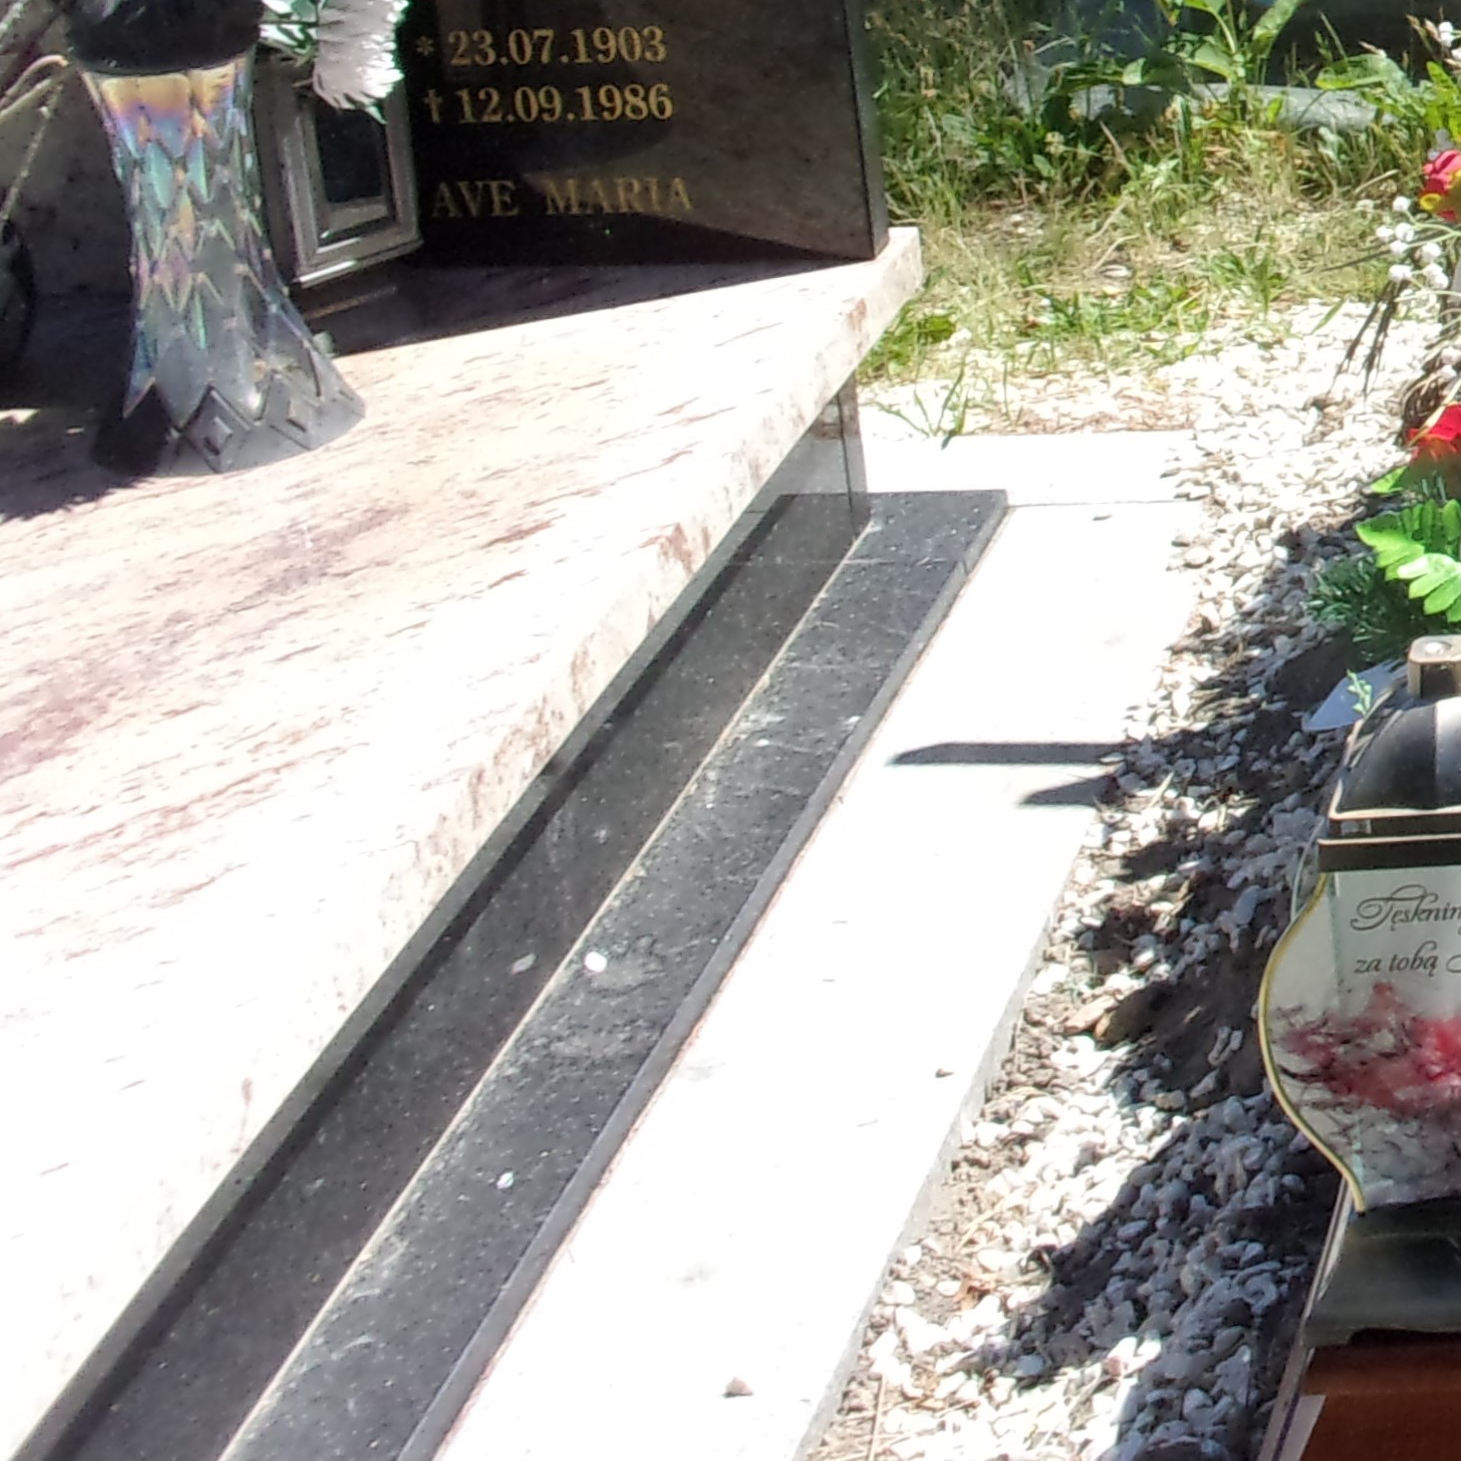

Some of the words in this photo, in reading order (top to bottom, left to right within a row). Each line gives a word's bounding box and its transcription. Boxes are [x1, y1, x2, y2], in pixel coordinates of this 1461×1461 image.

[447, 27, 668, 67] 23.07.1903
[457, 84, 676, 124] 12.09.1986
[434, 180, 517, 218] AVE
[544, 176, 693, 217] MARIA
[1354, 957, 1381, 974] za
[1388, 940, 1439, 978] tobą
